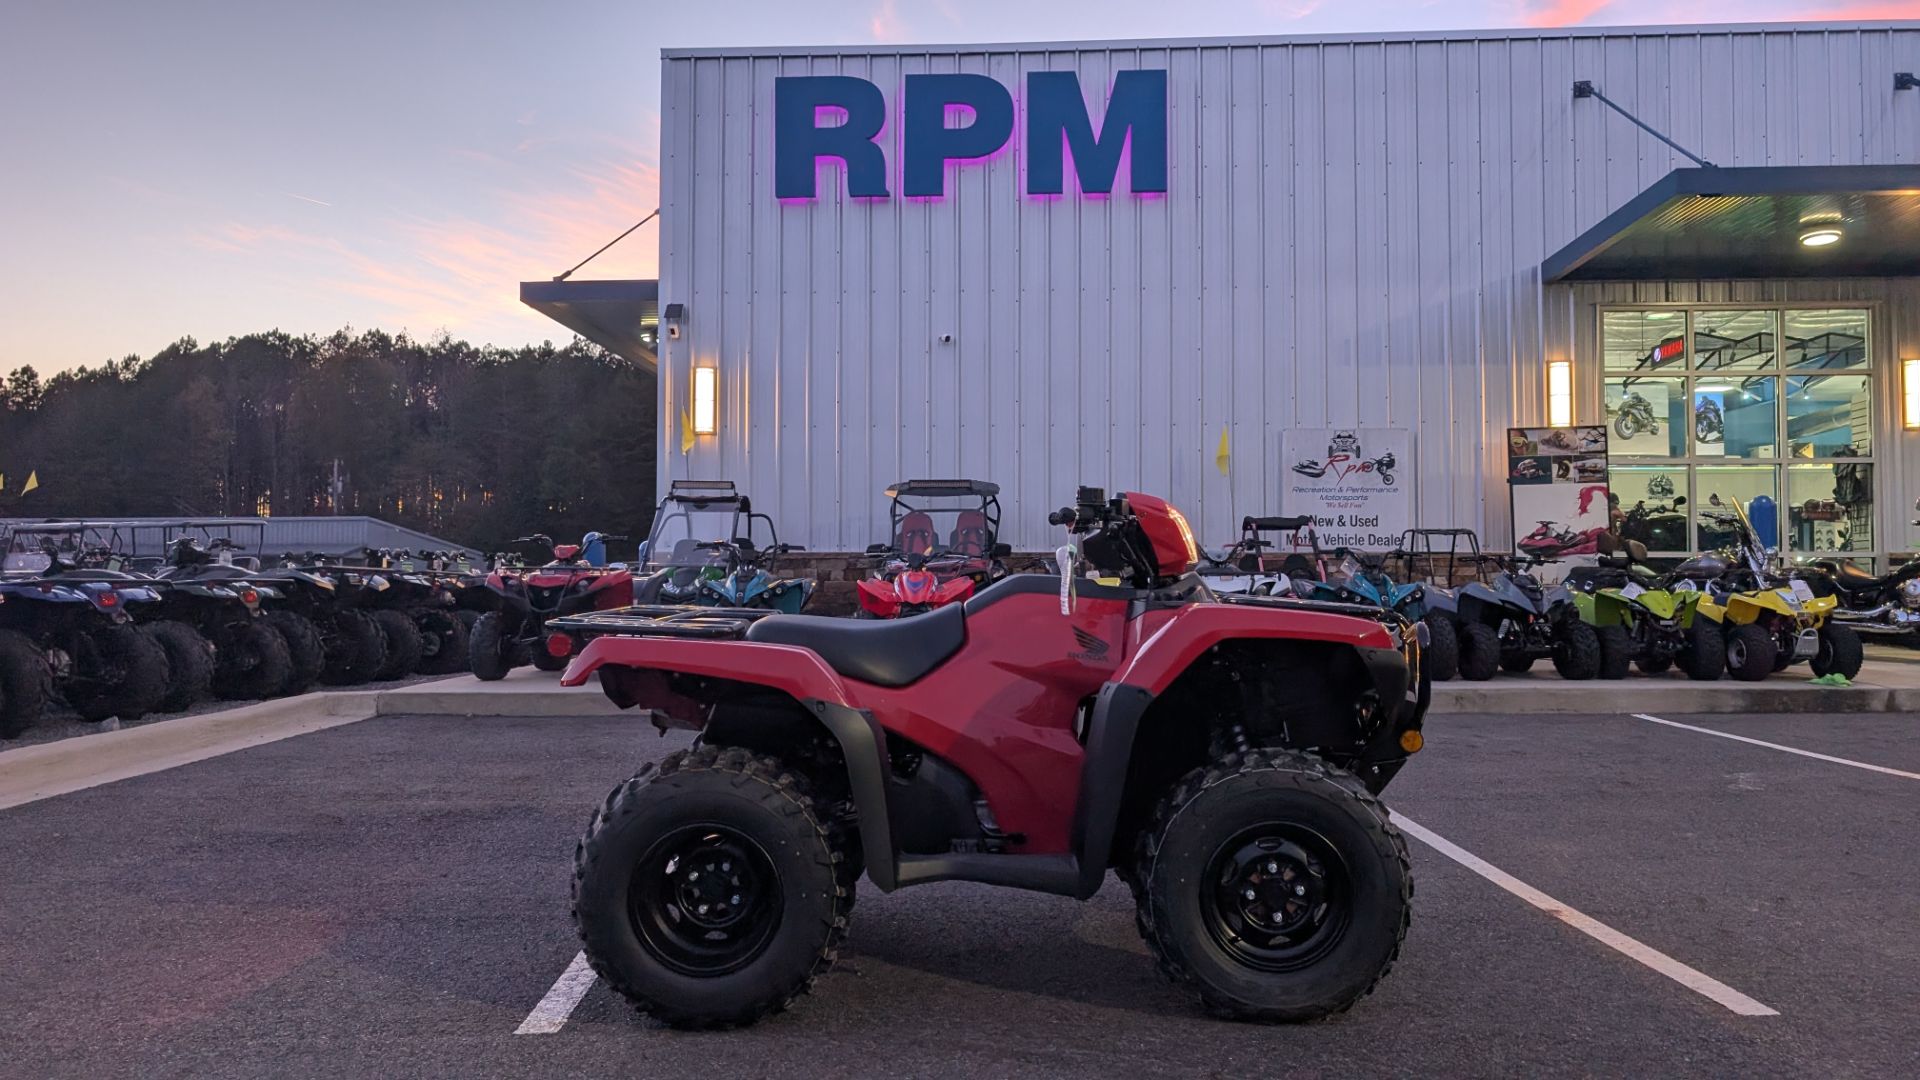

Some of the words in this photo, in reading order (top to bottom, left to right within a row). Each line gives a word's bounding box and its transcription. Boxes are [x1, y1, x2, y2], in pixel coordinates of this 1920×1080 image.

[775, 69, 1167, 199] RPM
[1661, 339, 1683, 359] YAMAHA
[1309, 515, 1334, 527] New
[1337, 515, 1346, 527] &
[1350, 515, 1379, 527] Used
[1323, 533, 1365, 546] Vehicle
[1368, 533, 1406, 546] Dealer
[1067, 651, 1109, 662] HONDA
